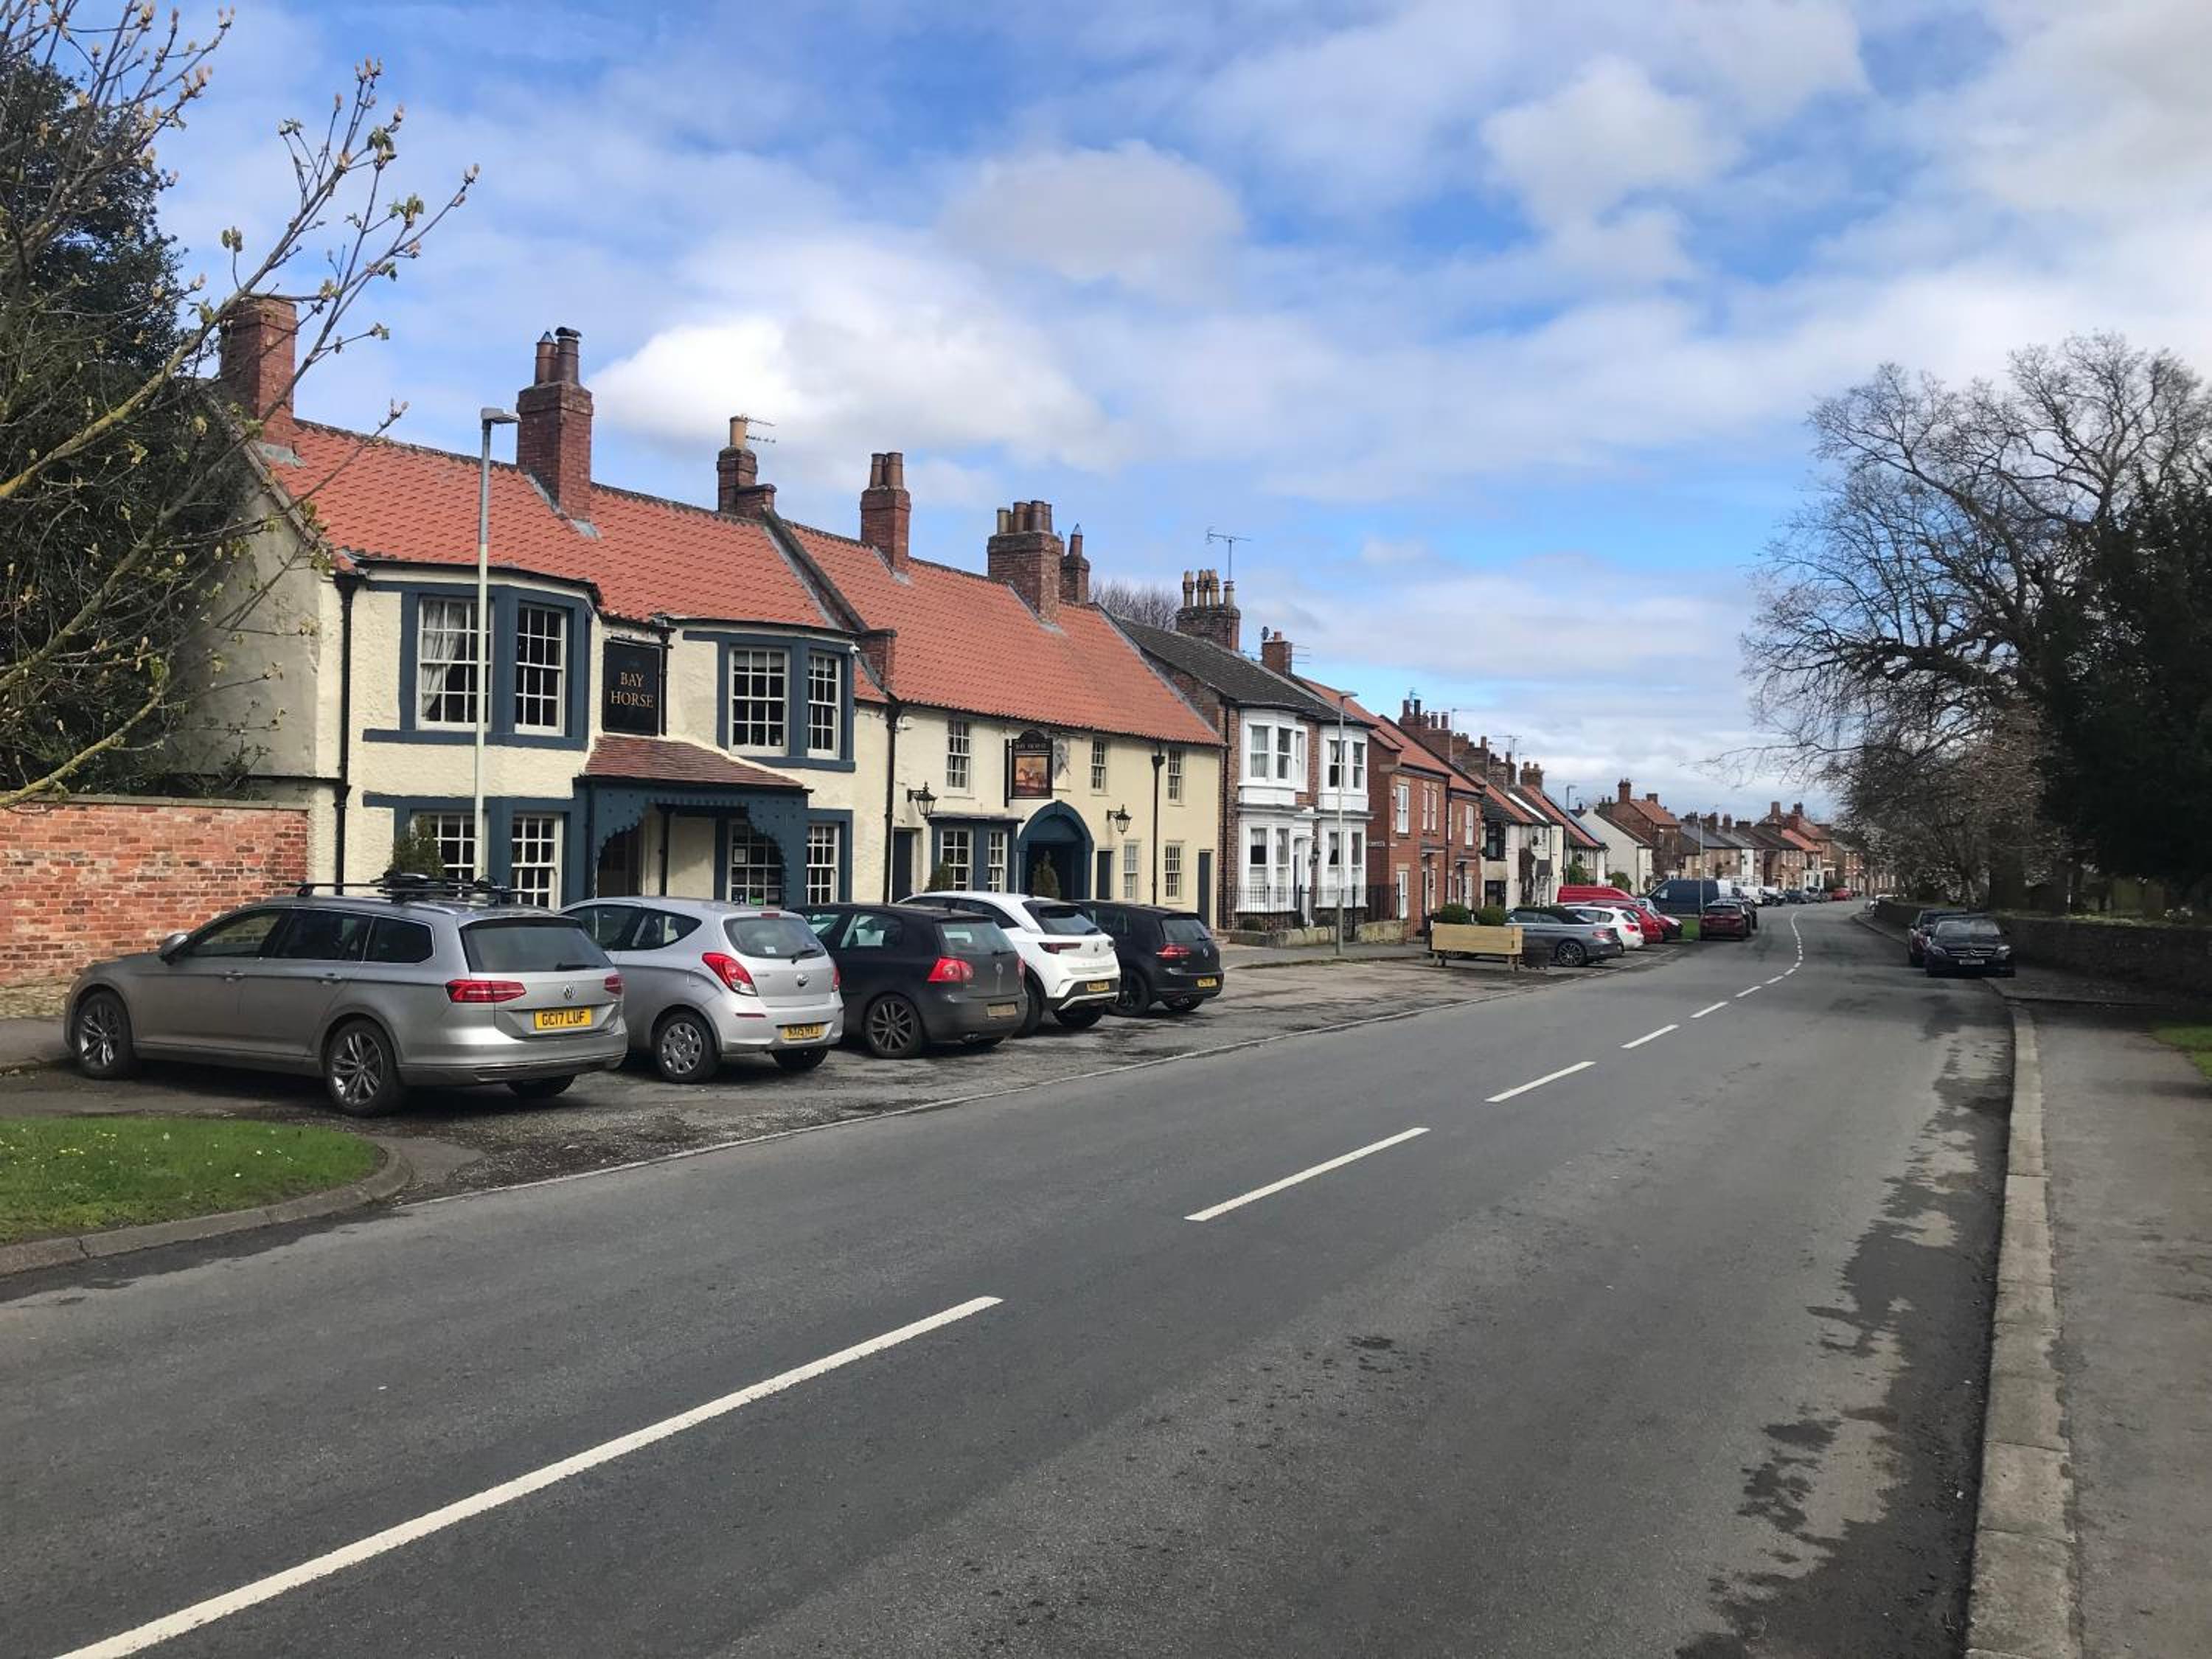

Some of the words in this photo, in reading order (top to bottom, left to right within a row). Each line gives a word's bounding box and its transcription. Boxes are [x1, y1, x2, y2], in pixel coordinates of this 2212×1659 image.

[620, 672, 644, 687] BAY
[611, 691, 654, 708] HORSE
[542, 1012, 564, 1026] GC17
[566, 1011, 585, 1024] LUF
